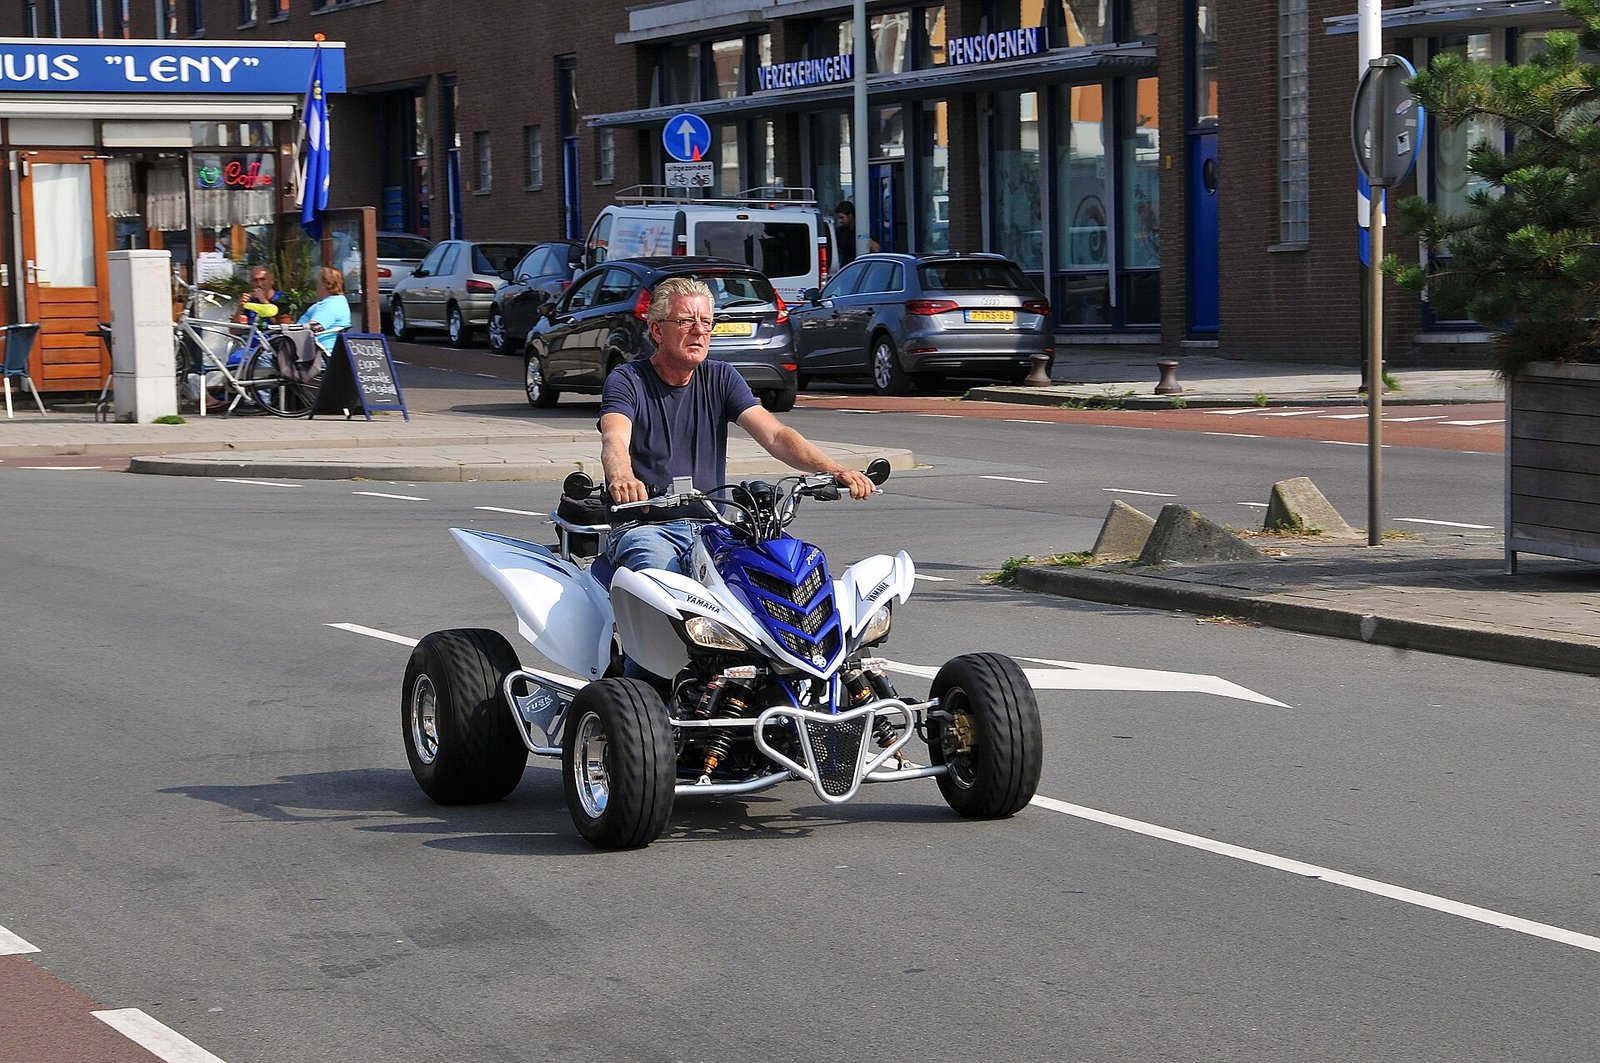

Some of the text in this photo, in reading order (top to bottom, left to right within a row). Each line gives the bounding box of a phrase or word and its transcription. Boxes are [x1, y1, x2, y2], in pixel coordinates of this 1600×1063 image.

[949, 27, 1038, 66] PENSIOENEN
[0, 54, 80, 81] UIS
[757, 54, 851, 90] VERZEKERINGEN
[224, 161, 272, 188] Coffee
[686, 594, 721, 614] YAMAHA
[866, 582, 890, 602] YAMAHA
